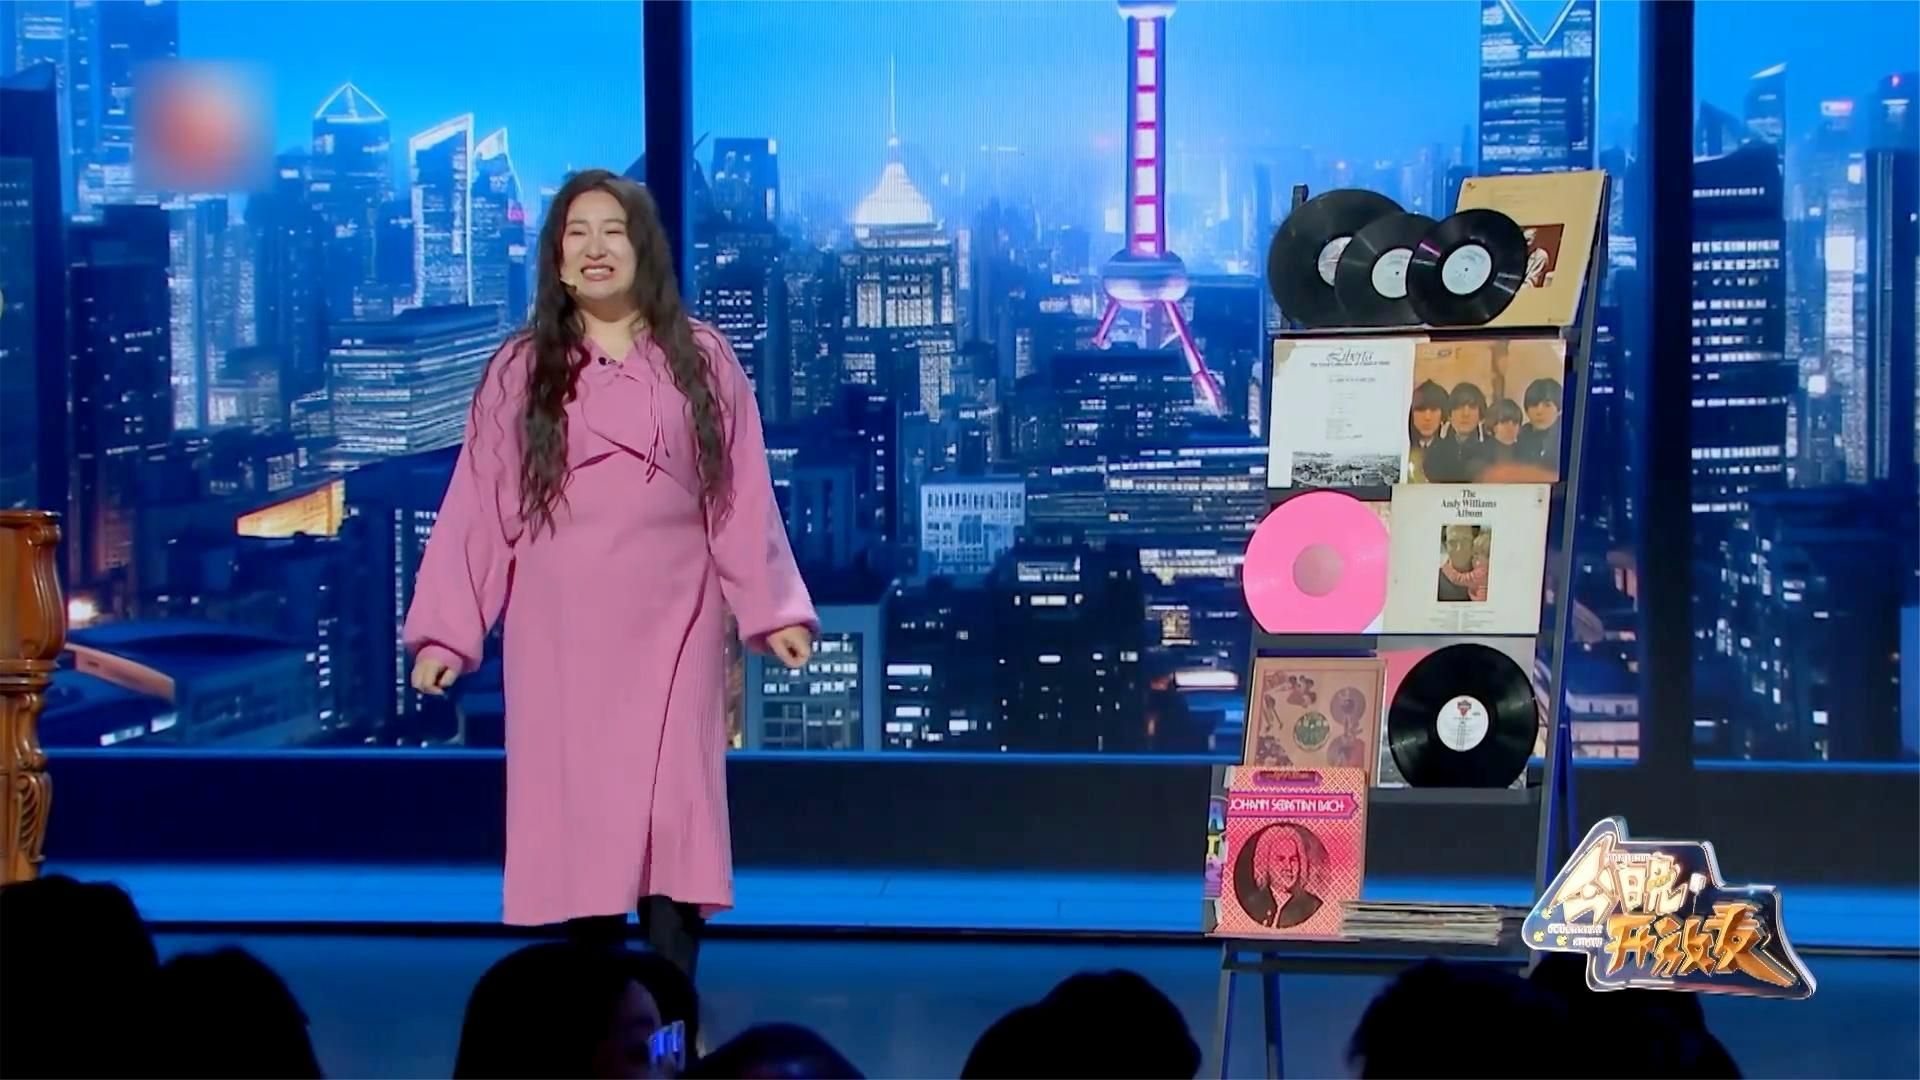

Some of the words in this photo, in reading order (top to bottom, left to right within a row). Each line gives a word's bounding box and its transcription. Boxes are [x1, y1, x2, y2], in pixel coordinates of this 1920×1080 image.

[1461, 489, 1476, 498] The
[1441, 499, 1461, 509] Andy
[1462, 499, 1497, 508] Williams
[1456, 509, 1483, 518] Album
[1229, 798, 1269, 811] JOHANN
[1271, 798, 1316, 812] SEBASTIAN
[1318, 799, 1345, 812] BACH
